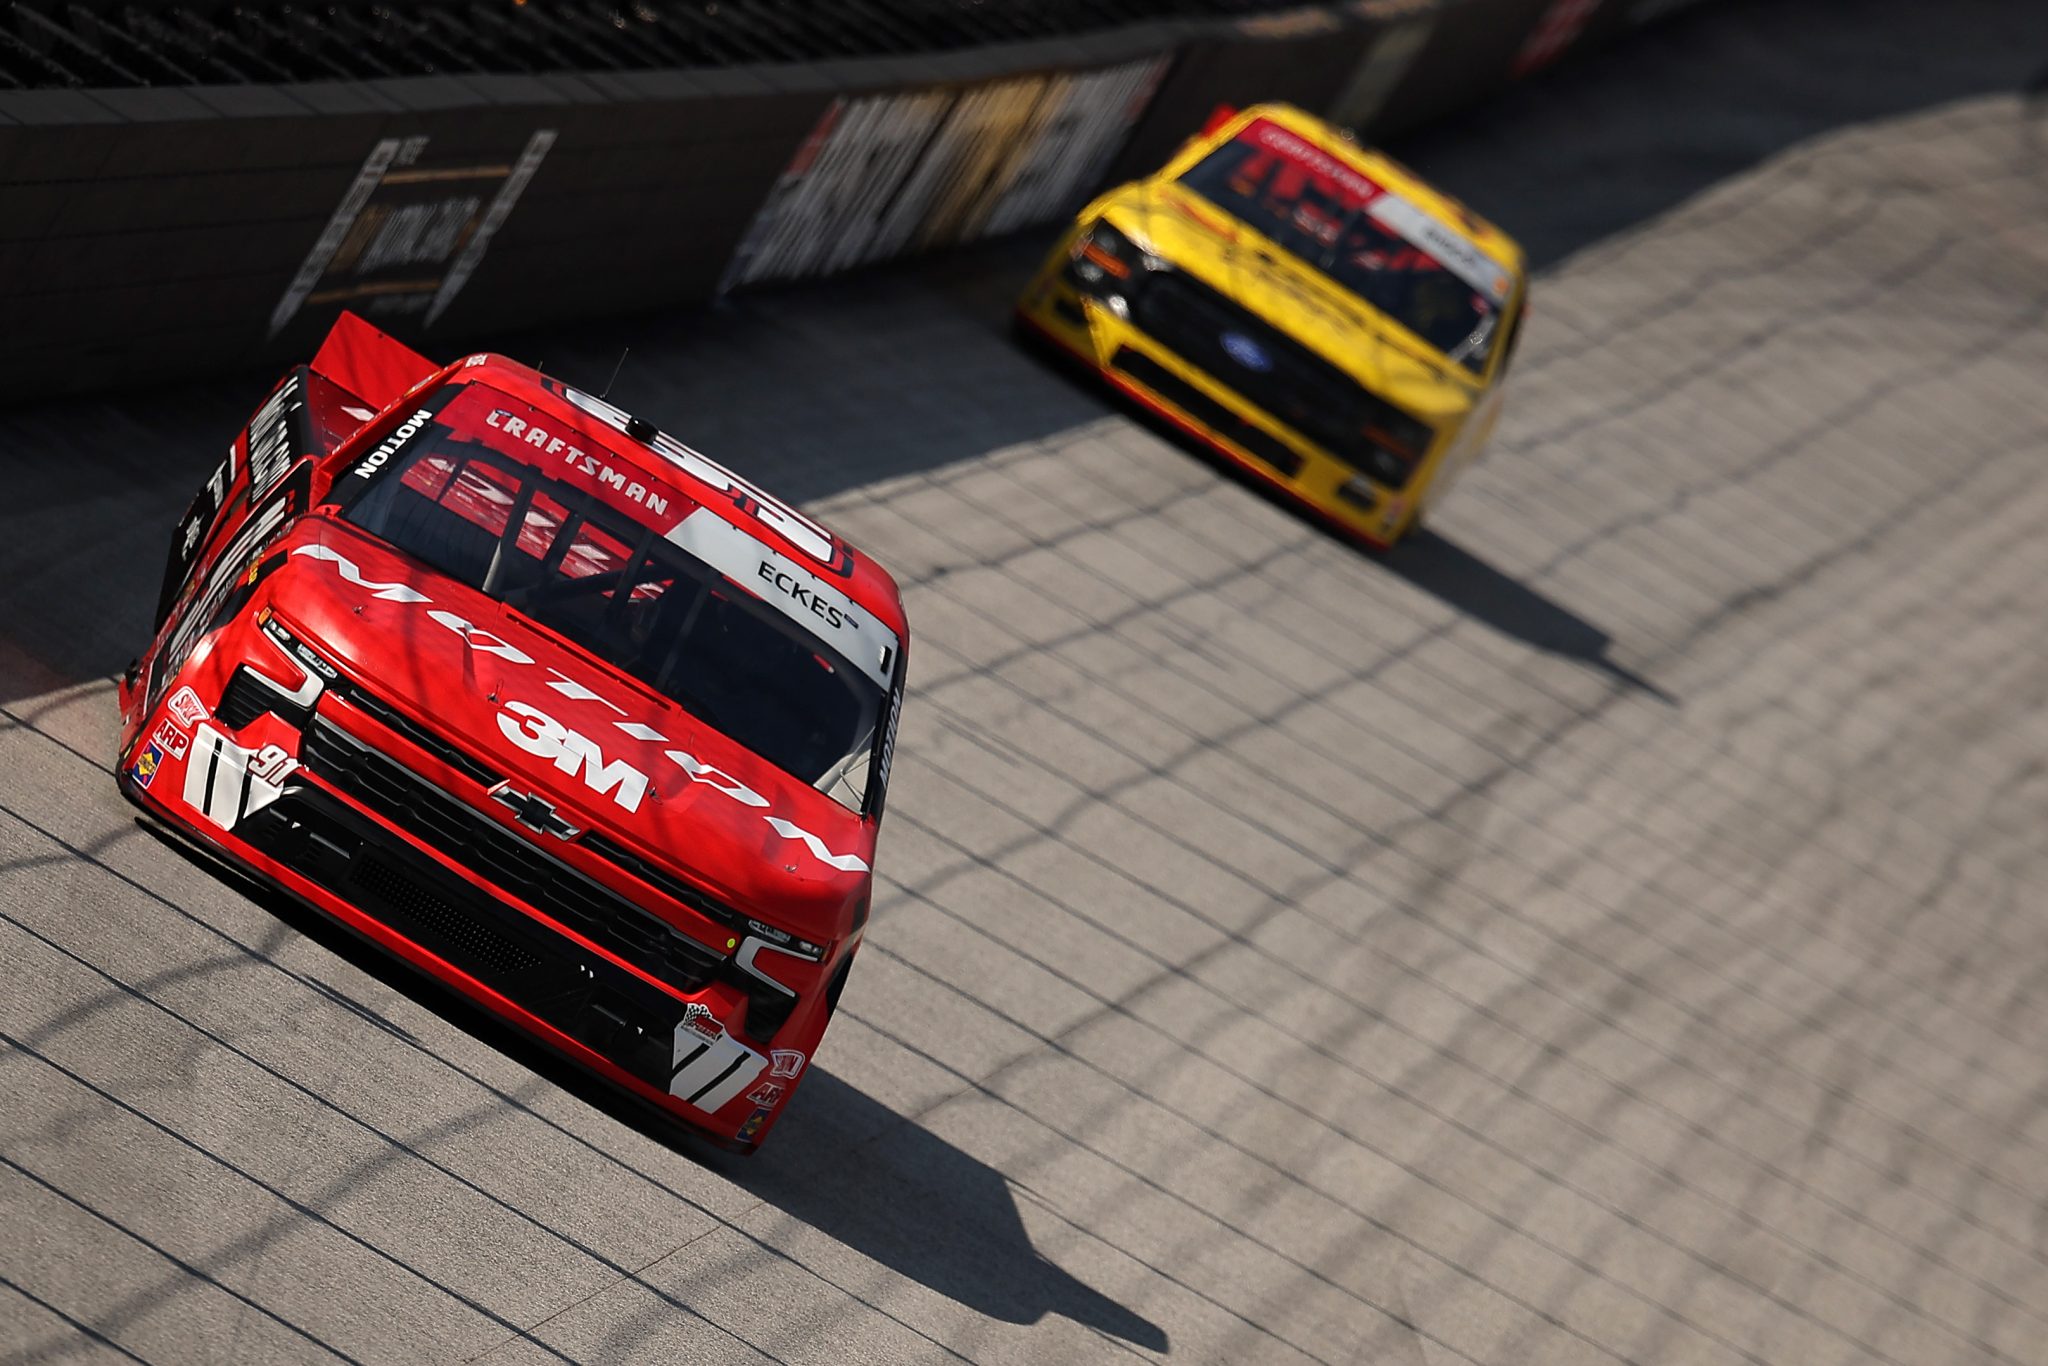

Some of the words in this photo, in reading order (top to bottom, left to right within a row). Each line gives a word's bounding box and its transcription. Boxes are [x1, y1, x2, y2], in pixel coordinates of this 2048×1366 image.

[354, 409, 432, 479] MOTION
[486, 410, 667, 516] CRAFTSMAN
[757, 560, 843, 629] ECKES
[156, 720, 188, 751] ARP
[249, 744, 298, 787] 91
[496, 701, 649, 814] 3M
[879, 687, 901, 788] MOTION
[750, 1083, 785, 1104] AR
